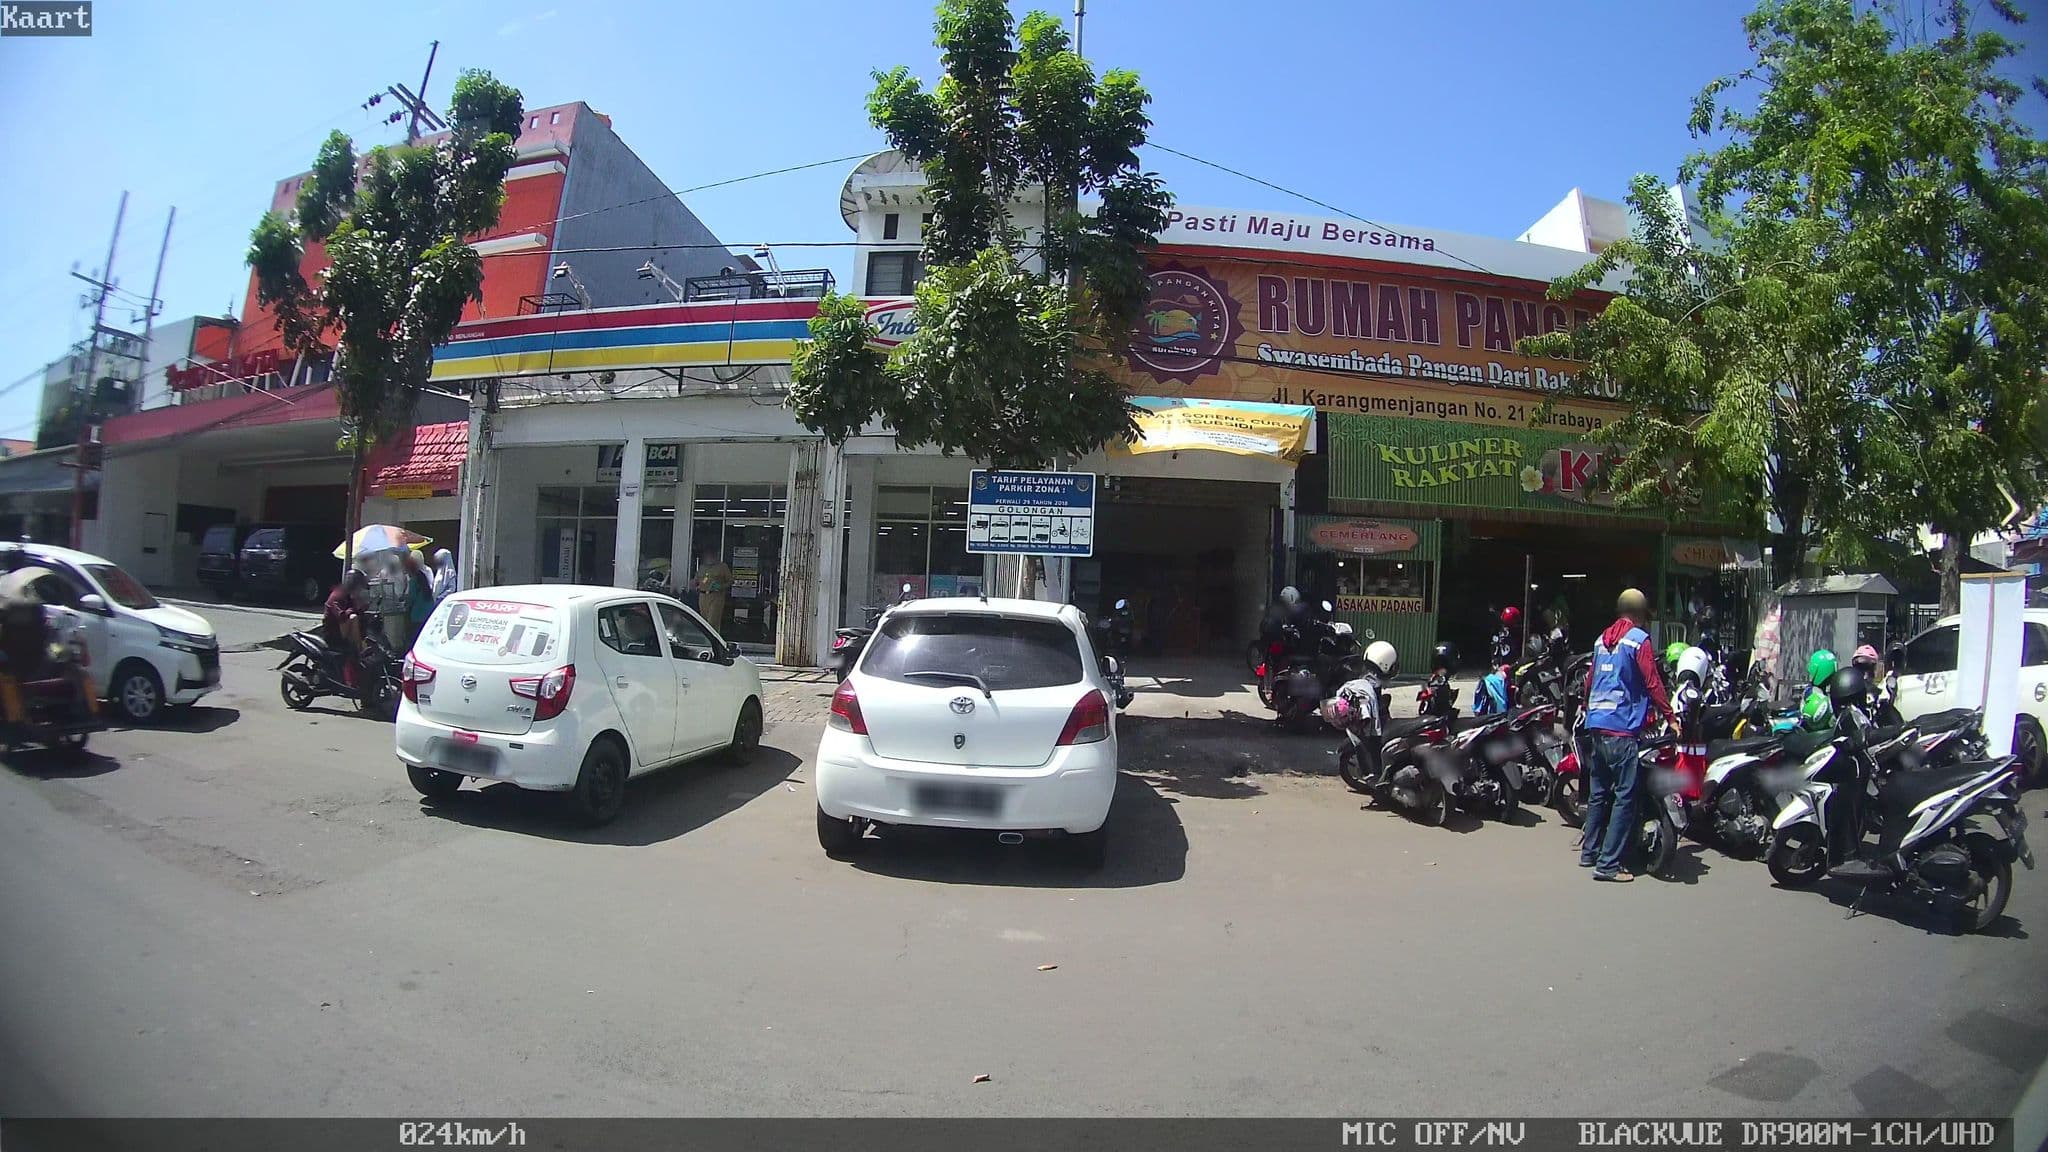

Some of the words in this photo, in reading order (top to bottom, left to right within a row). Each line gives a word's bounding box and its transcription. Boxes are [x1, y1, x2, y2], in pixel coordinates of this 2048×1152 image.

[1166, 211, 1237, 233] Pasti
[1247, 216, 1311, 241] Maju
[1322, 223, 1435, 251] Bersama
[1257, 274, 1441, 345] RUMAH
[1455, 291, 1591, 361] PANG
[1257, 343, 1403, 376] Swasembada
[1408, 354, 1484, 386] Pangan
[1488, 362, 1531, 389] Dari
[1272, 387, 1294, 405] Jl.
[1302, 389, 1468, 419] Karangmenjangan
[1475, 403, 1502, 419] No.
[1508, 405, 1525, 421] 21
[1531, 408, 1602, 430] urabaya
[1251, 419, 1302, 430] CURAH
[648, 445, 677, 460] BCA
[1376, 437, 1523, 465] KULINER
[992, 475, 1018, 483] TARIF
[1020, 476, 1074, 485] PELAYANAN
[1392, 459, 1517, 488] RAKYAT
[999, 484, 1033, 493] PARKIR
[1035, 485, 1060, 493] ZONA
[998, 505, 1064, 515] GOLONGAN
[1319, 529, 1408, 541] CEMERLANG
[475, 601, 518, 612] SHARP
[1336, 598, 1378, 613] ASAKAN
[1381, 600, 1421, 613] PADANG
